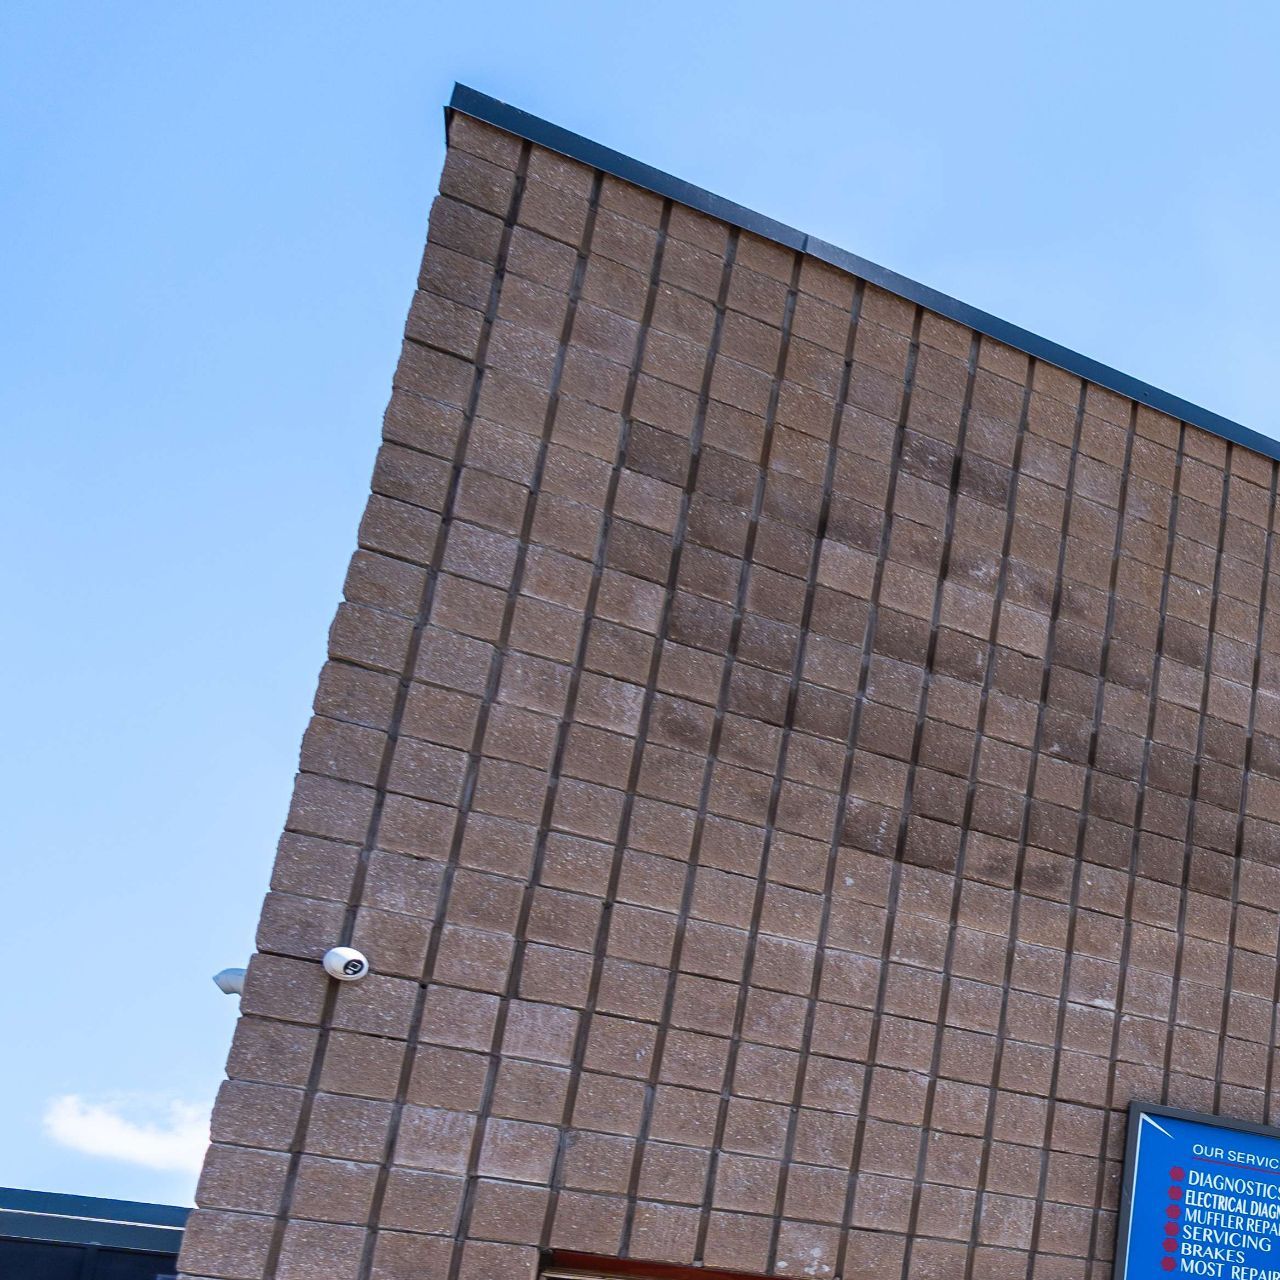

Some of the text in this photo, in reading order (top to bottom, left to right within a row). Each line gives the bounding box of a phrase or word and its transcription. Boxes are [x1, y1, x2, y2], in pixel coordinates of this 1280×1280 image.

[1192, 1143, 1224, 1159] OUR
[1185, 1190, 1249, 1215] ELECTRICAL
[1184, 1209, 1245, 1231] MUFFLER
[1182, 1226, 1272, 1252] SERVICING
[1180, 1243, 1245, 1264] BRAKES
[1180, 1259, 1222, 1278] MOST
